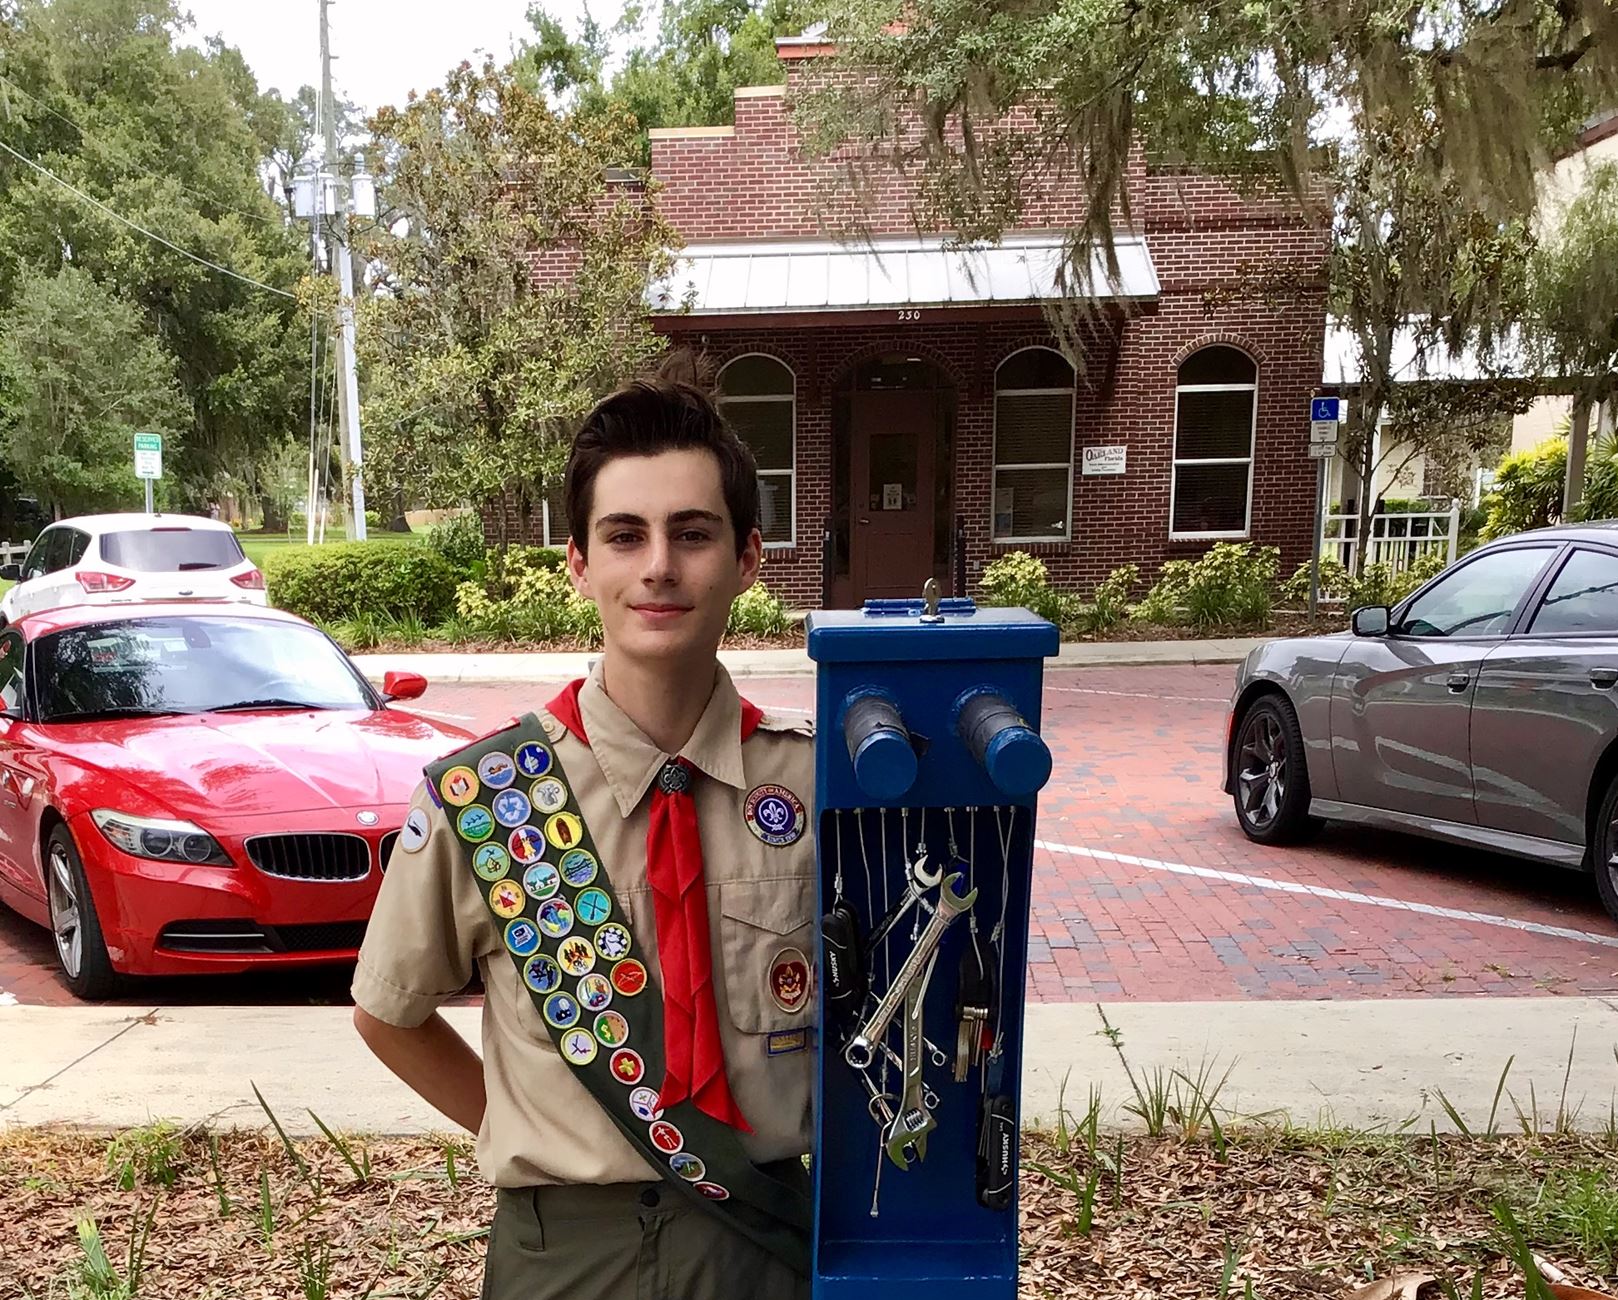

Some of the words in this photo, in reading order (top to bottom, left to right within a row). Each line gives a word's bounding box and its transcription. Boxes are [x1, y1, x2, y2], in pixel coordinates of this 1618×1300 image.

[1086, 448, 1124, 461] OAKLAND
[775, 788, 800, 808] AMERICA
[829, 950, 838, 978] HUSKY
[1002, 1132, 1010, 1164] HUSKY
